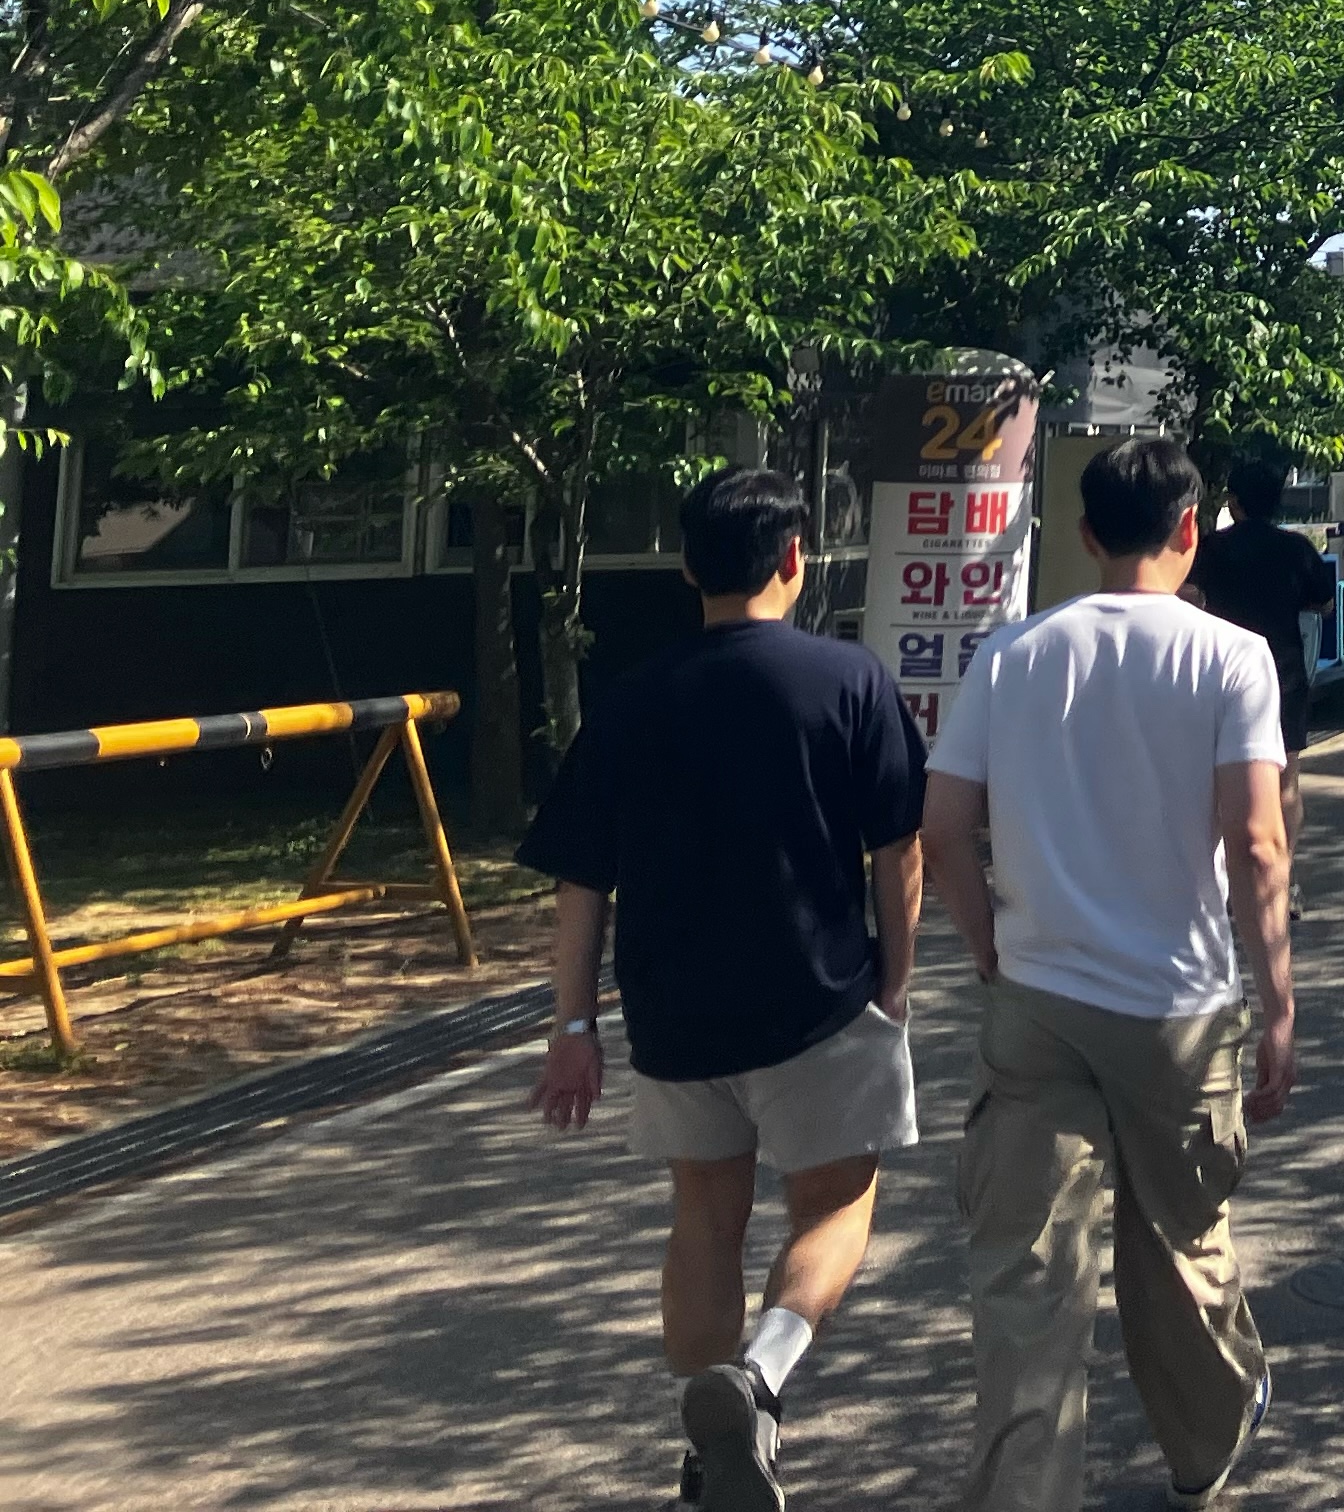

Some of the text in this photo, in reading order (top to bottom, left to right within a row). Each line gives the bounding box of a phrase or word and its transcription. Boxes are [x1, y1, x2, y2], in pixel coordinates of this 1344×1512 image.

[920, 404, 1002, 461] 24
[907, 491, 1009, 535] 담배
[901, 561, 1004, 606] 와인
